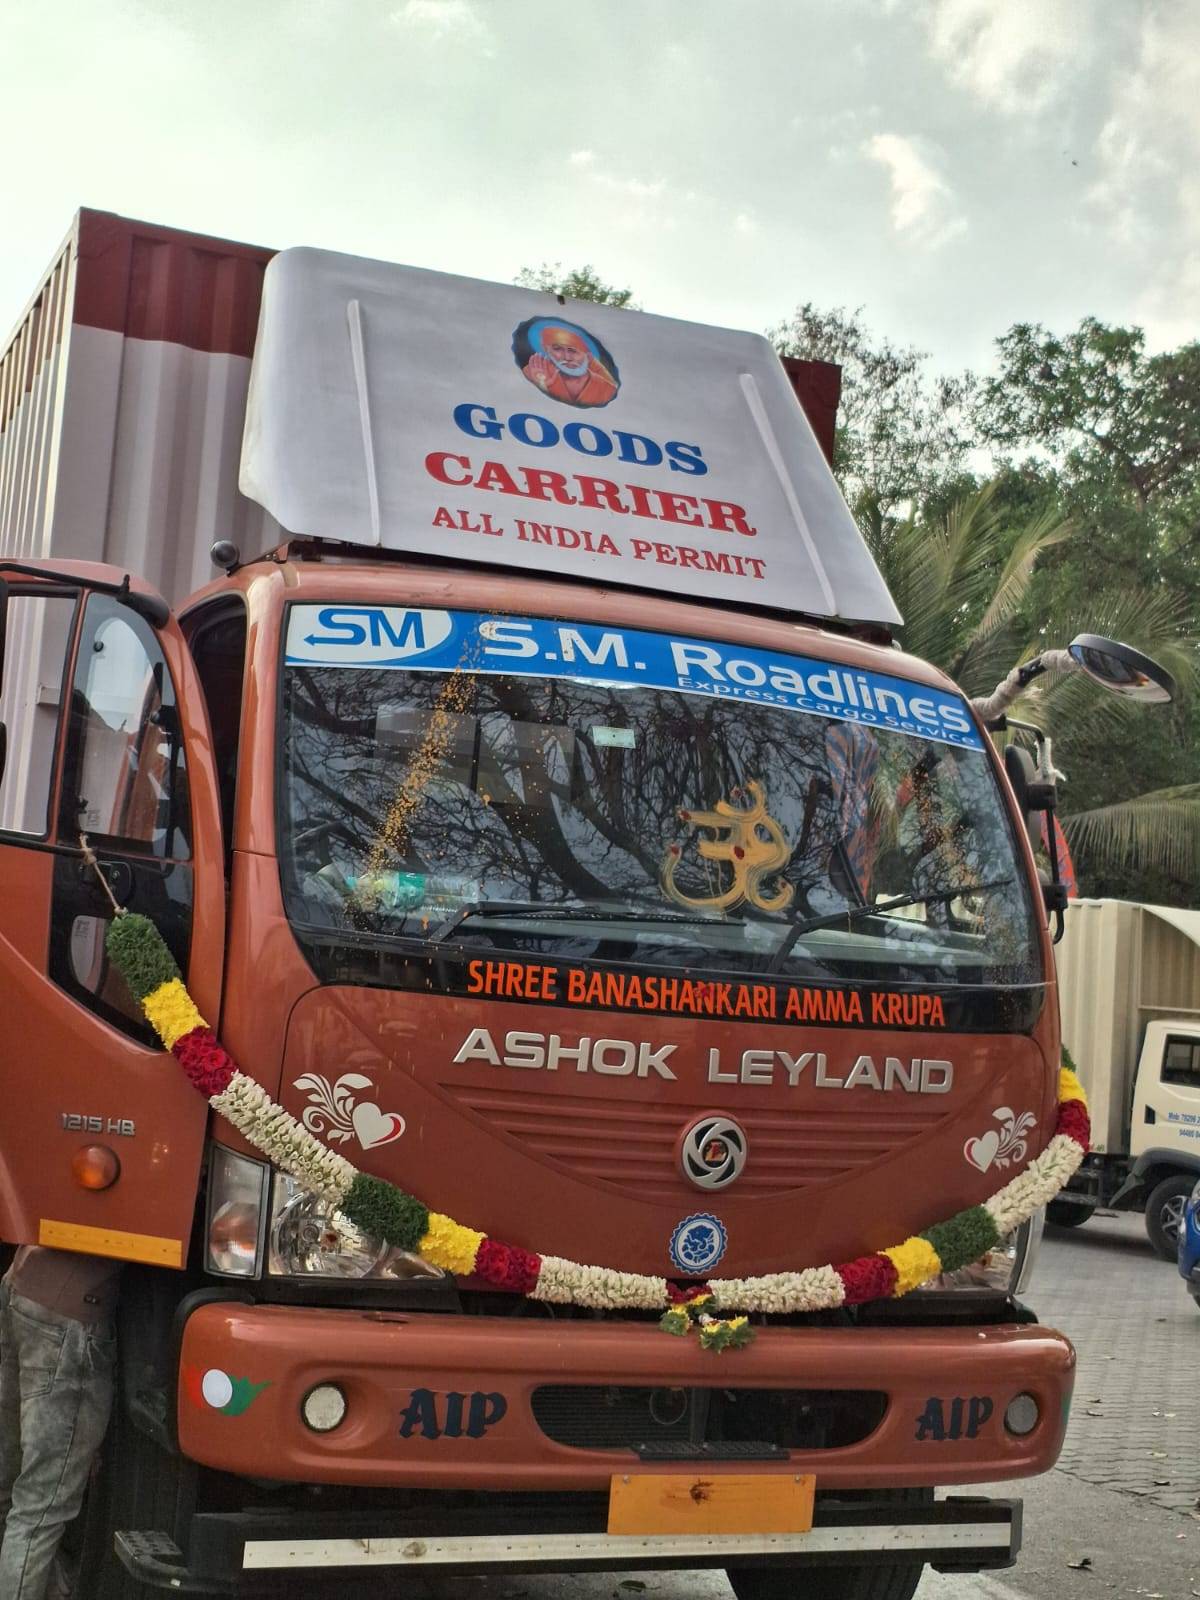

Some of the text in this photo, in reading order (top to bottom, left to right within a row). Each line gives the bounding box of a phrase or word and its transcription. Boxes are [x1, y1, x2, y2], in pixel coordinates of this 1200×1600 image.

[453, 403, 708, 476] GOODS
[425, 452, 757, 536] CARRIER
[432, 506, 767, 579] ALL INDIA PERMIT
[303, 608, 426, 649] SM
[478, 621, 971, 733] S.M. Roadlines
[678, 677, 976, 746] Express Cargo Service
[467, 959, 946, 1028] SHREE BANASHANKARI AMMA KRUPA
[452, 1028, 954, 1095] ASHOK LEYLAND
[61, 1112, 136, 1136] 1215 HB
[399, 1387, 508, 1440] AIP
[914, 1396, 994, 1441] AIP
